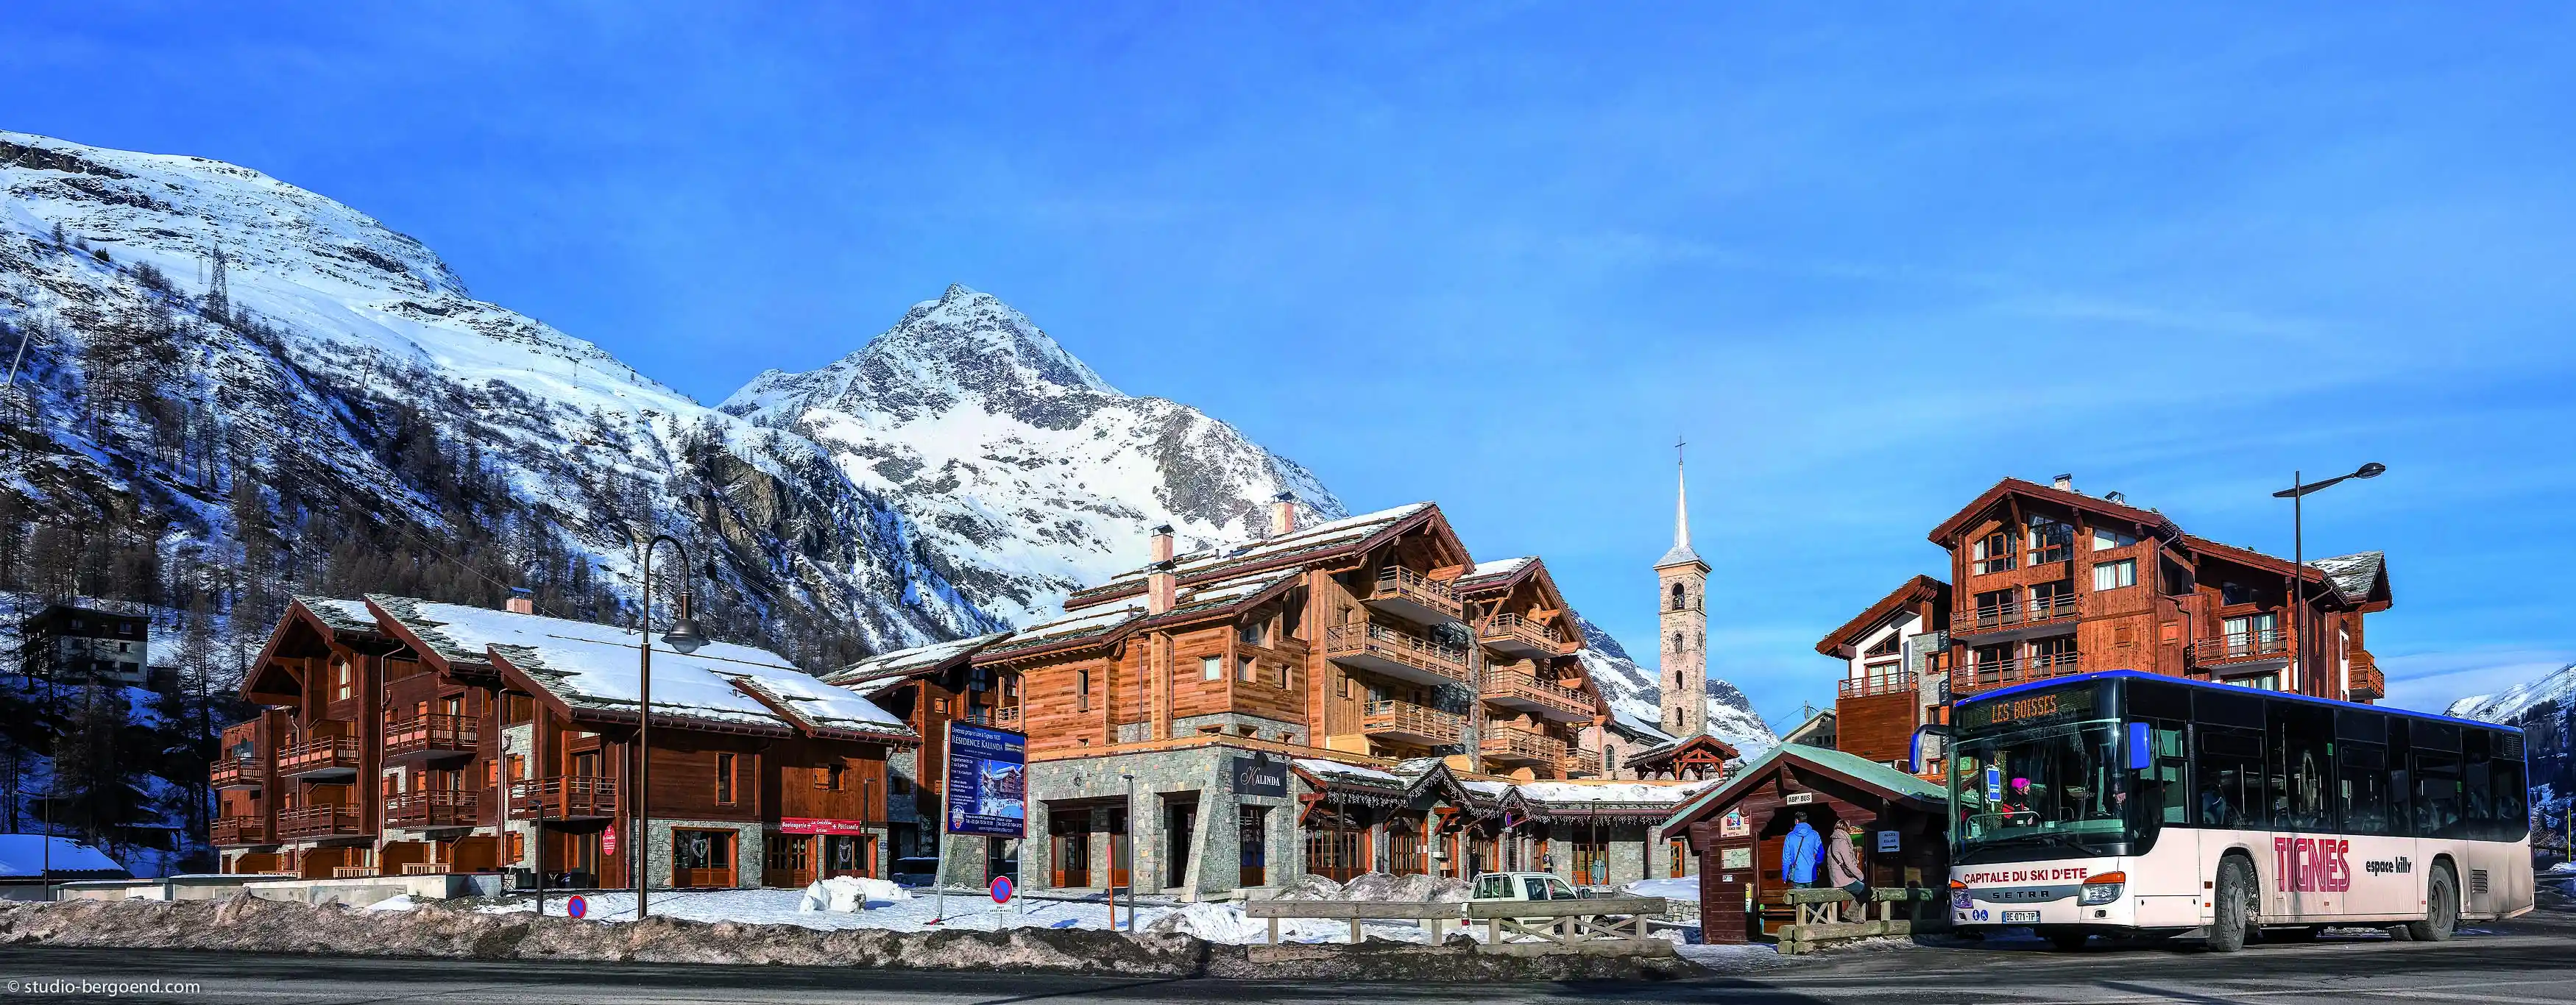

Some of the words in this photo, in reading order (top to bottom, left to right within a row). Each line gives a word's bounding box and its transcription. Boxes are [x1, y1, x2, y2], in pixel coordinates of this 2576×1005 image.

[1992, 703, 2009, 723] LES
[2014, 694, 2056, 720] BOISSES
[952, 734, 980, 747] RÉSIDENCE
[981, 739, 1003, 751] KALINDA
[1240, 765, 1281, 786] KALINDA
[782, 821, 807, 829] Boulangerie
[2274, 837, 2352, 892] TIGNES
[2366, 859, 2394, 876] espace
[2395, 856, 2412, 873] killy
[1964, 871, 2009, 884] CAPITALE
[2012, 870, 2027, 881] DU
[2030, 869, 2048, 881] SKI
[2052, 867, 2087, 880] D'ETE
[1992, 890, 2050, 899] SETRA
